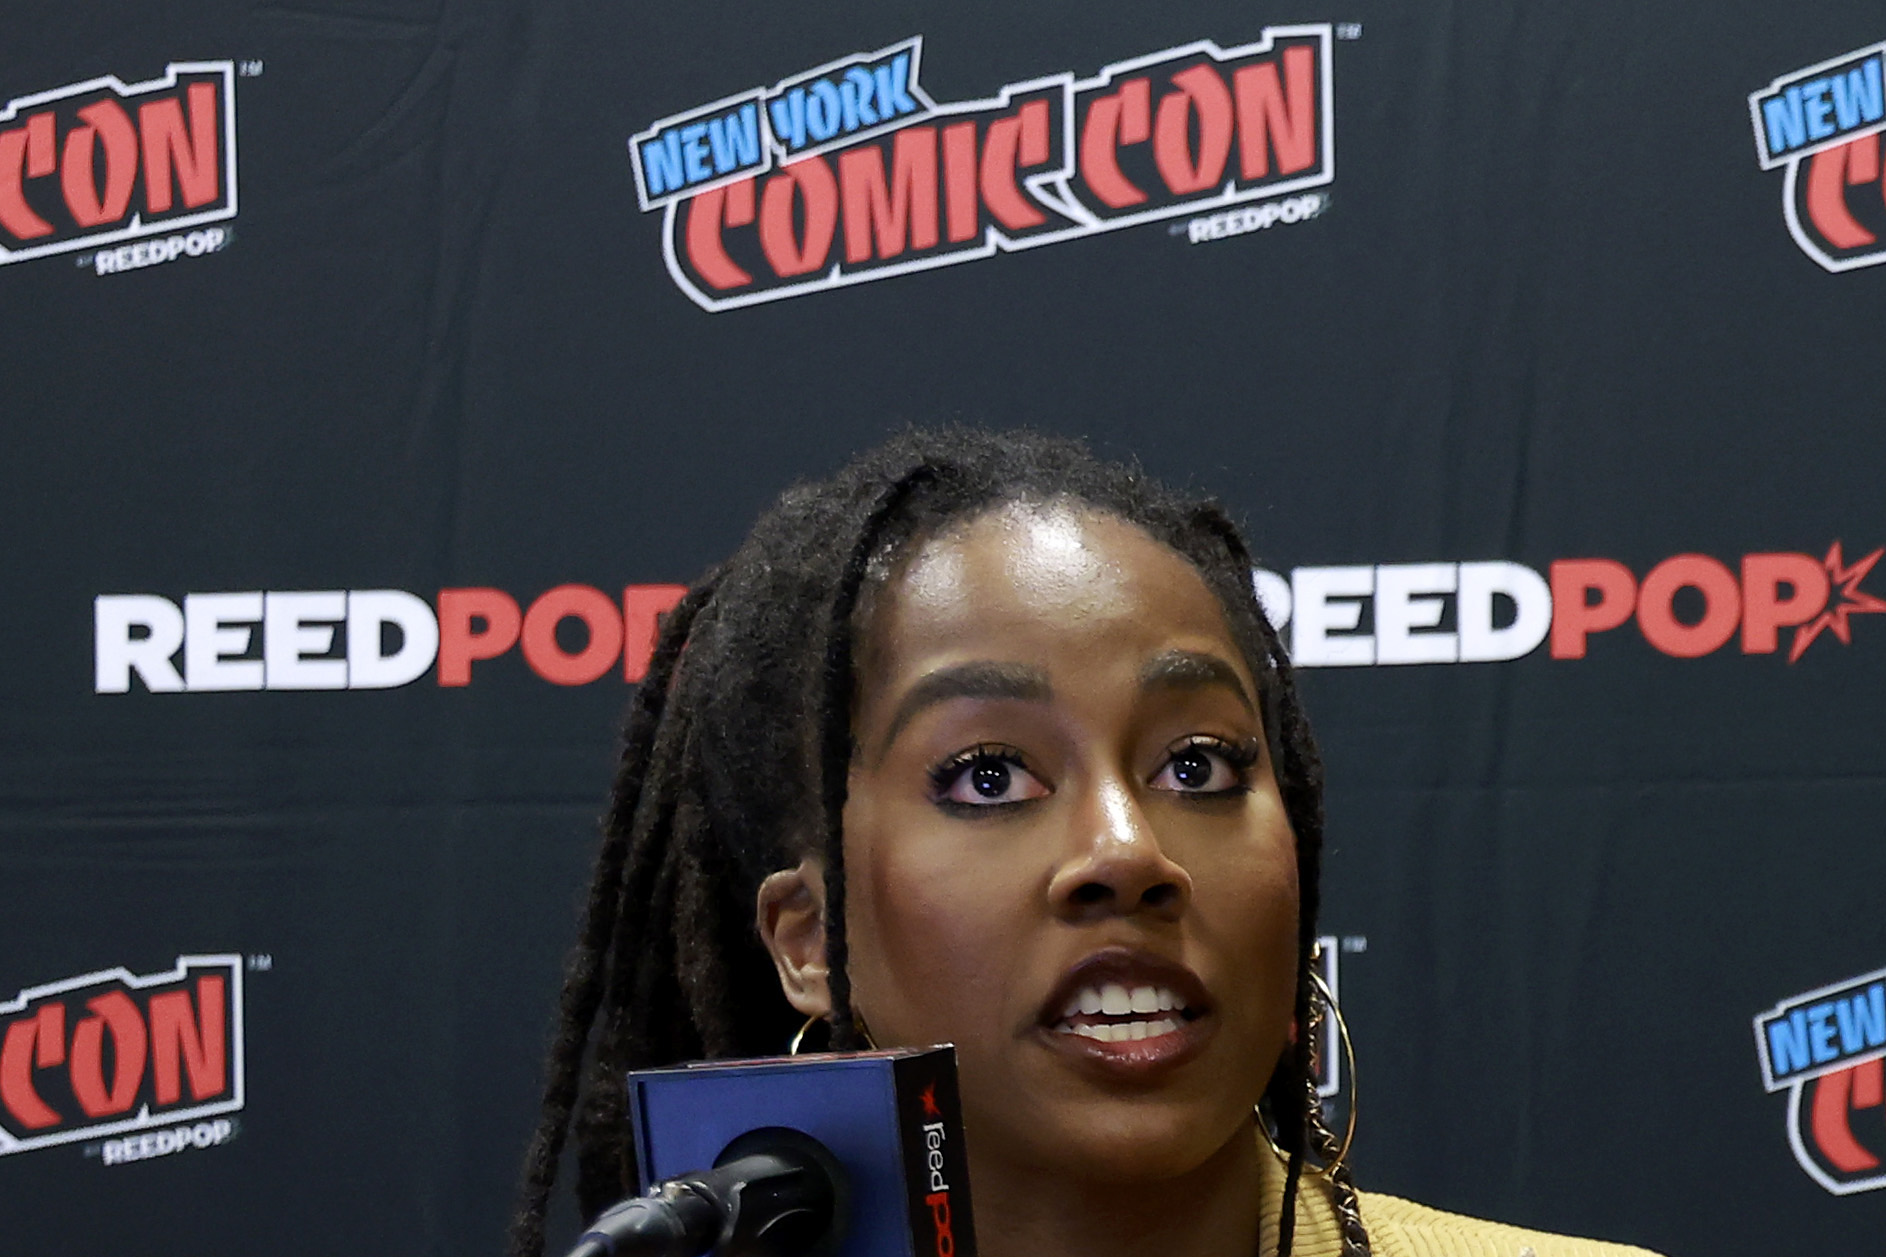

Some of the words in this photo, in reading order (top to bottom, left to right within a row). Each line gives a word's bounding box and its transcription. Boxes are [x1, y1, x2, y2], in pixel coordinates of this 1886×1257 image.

[0, 82, 219, 240] CON
[642, 103, 759, 195] NEW
[771, 53, 916, 149] YORK
[1764, 59, 1883, 153] NEW
[686, 100, 1050, 290] COMIC
[1080, 45, 1316, 209] CON
[1189, 194, 1320, 244] REEDPOP
[95, 226, 225, 276] REEDPOP
[0, 976, 226, 1130] CON
[102, 1119, 232, 1166] REEDPOP
